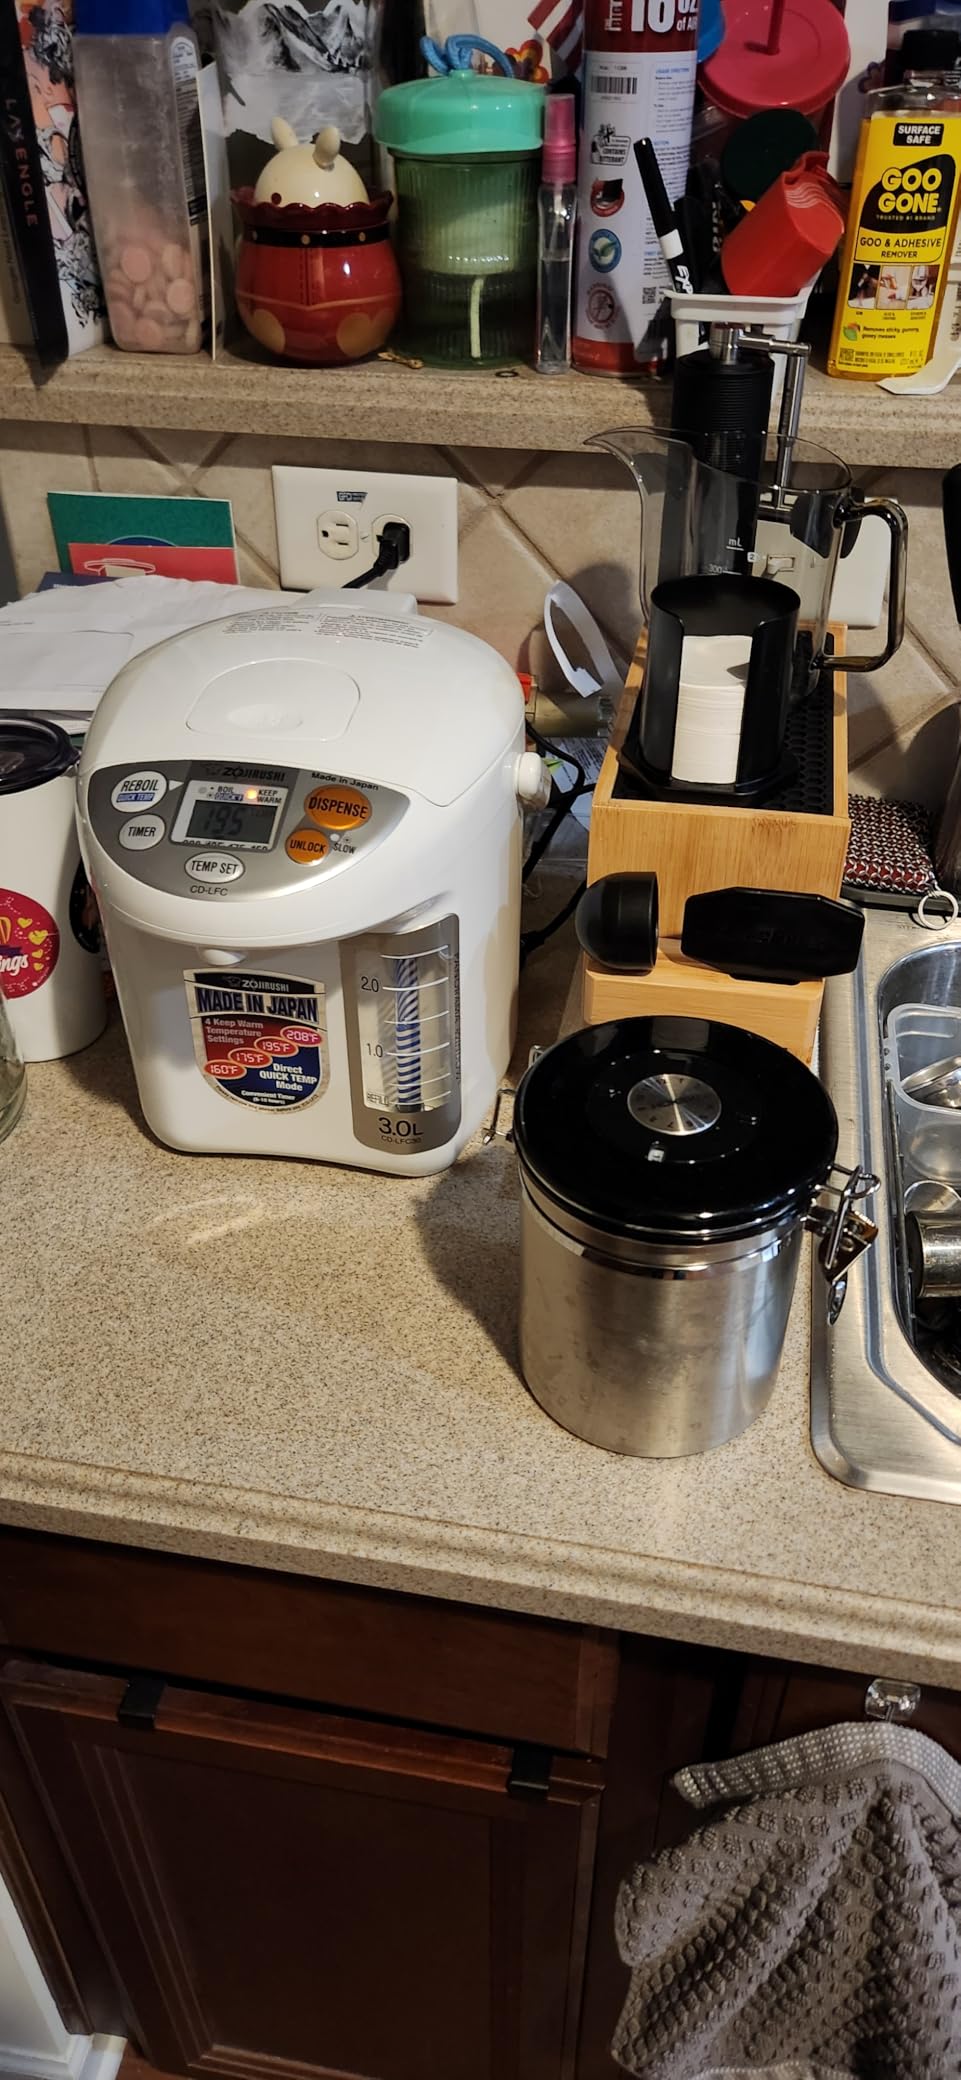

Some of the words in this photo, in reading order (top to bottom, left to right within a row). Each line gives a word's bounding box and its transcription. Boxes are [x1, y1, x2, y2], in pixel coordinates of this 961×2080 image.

[897, 124, 942, 135] SURFACE
[906, 135, 932, 144] SAFE
[882, 167, 943, 192] GOO
[878, 192, 940, 213] GONE
[860, 237, 882, 248] GOO
[884, 237, 891, 248] &
[894, 238, 942, 248] ADHESIVE
[728, 537, 743, 547] mL
[222, 767, 286, 781] ZOJIRUSHI
[120, 779, 159, 792] REBOIL
[311, 772, 336, 783] Made
[339, 776, 348, 784] in
[349, 780, 379, 791] Japan
[118, 794, 135, 802] QUICK
[258, 789, 278, 797] KEEP
[257, 796, 282, 804] WARM
[308, 796, 369, 819] DISPENSE
[128, 826, 157, 837] TIMER
[290, 839, 327, 854] UNLOCK
[333, 842, 356, 854] SLOW
[191, 860, 218, 874] TEMP
[220, 862, 240, 875] SET
[190, 884, 228, 896] CD-LFC
[242, 979, 290, 992] ZOJIRUSHI
[361, 976, 379, 992] 2.0
[196, 987, 243, 1013] MADE
[246, 993, 265, 1013] IN
[266, 995, 319, 1023] JAPAN
[213, 1018, 235, 1027] Keep
[237, 1019, 264, 1029] Warm
[206, 1026, 262, 1038] Temperature
[286, 1030, 319, 1043] 208°F
[207, 1035, 244, 1045] Settings
[262, 1041, 291, 1052] 195°F
[366, 1043, 384, 1058] 1.0
[236, 1052, 265, 1063] 175°F
[210, 1064, 239, 1075] 160°F
[272, 1063, 303, 1074] Direct
[259, 1071, 289, 1082] QUICK
[290, 1074, 318, 1085] TEMP
[275, 1081, 303, 1091] Mode
[241, 1090, 275, 1099] Convenient
[277, 1093, 296, 1101] Timer
[366, 1092, 389, 1105] REFILL
[378, 1117, 424, 1137] 3.0L
